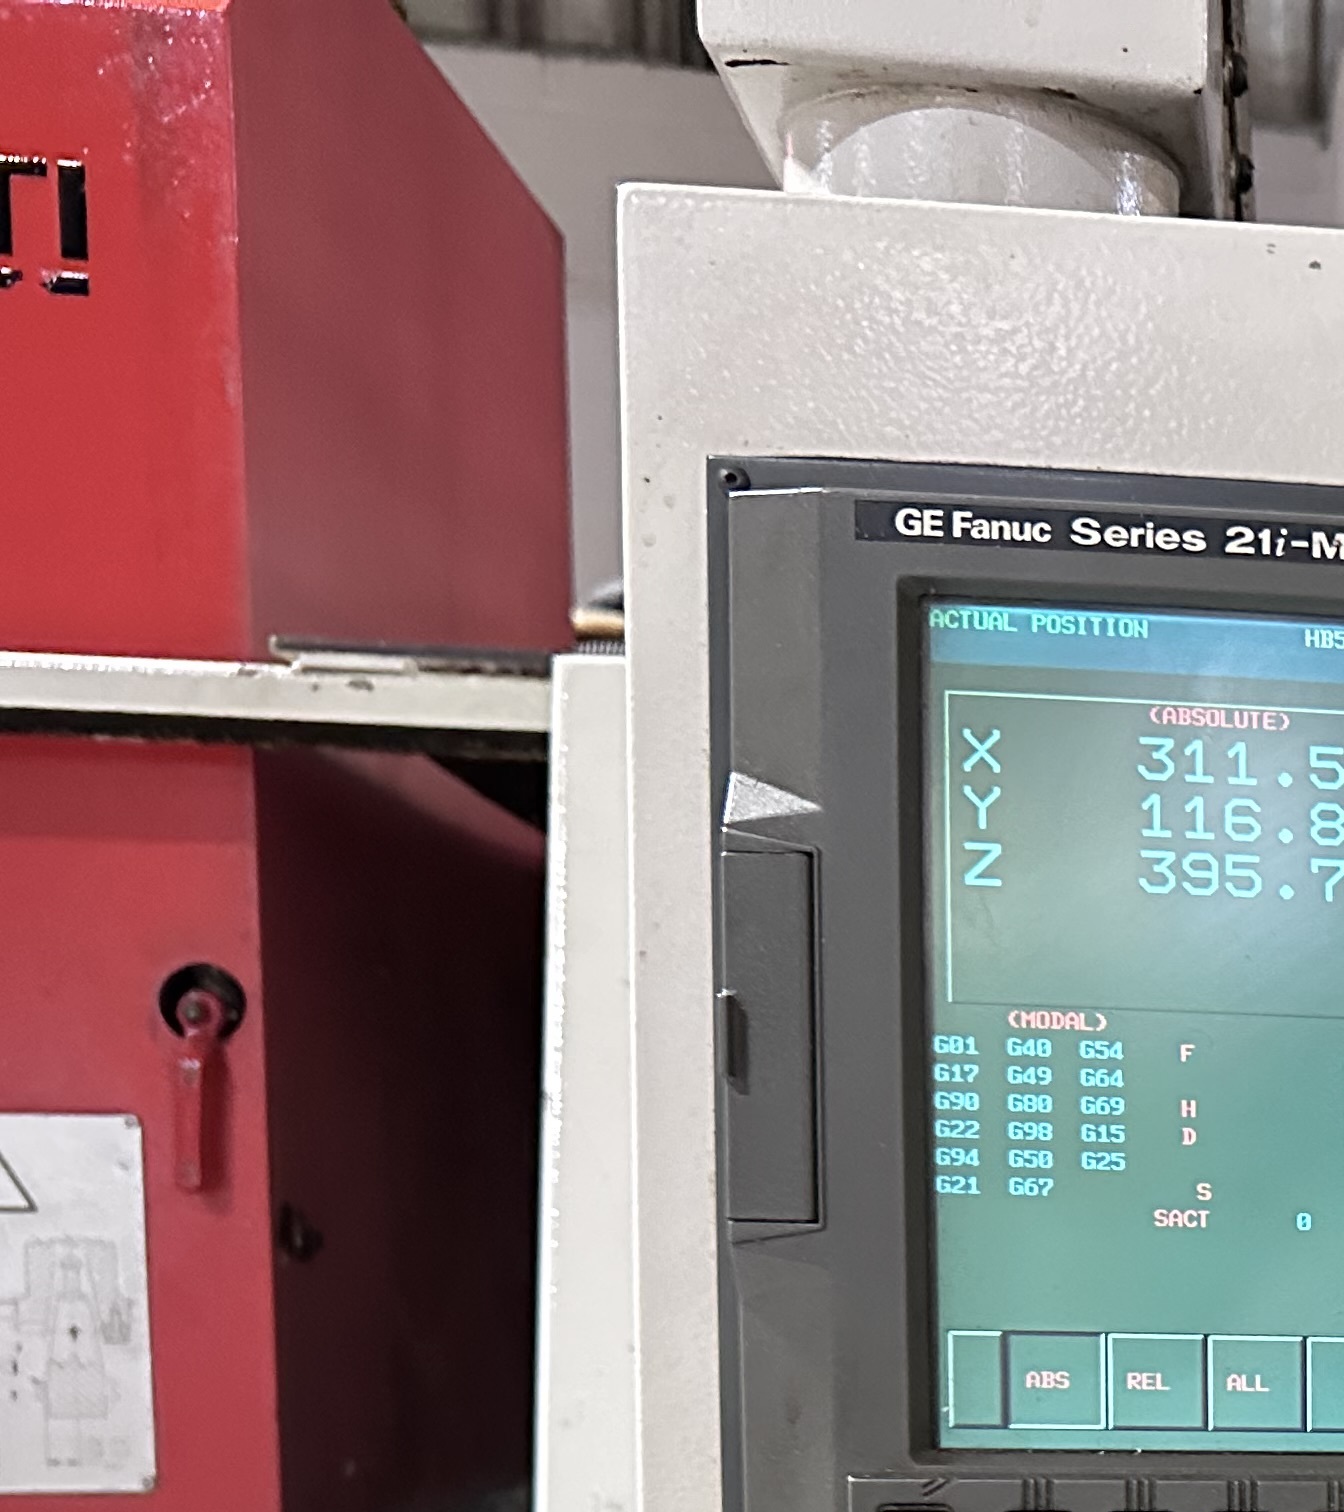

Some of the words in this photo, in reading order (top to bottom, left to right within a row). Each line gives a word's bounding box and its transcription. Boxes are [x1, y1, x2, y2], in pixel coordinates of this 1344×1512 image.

[895, 508, 944, 537] GE
[953, 511, 1051, 542] Fanuc
[1070, 516, 1206, 554] Series
[930, 609, 1017, 633] ACTUAL
[1031, 614, 1149, 639] POSITION
[1149, 706, 1291, 732] (ABSOLUTE)
[963, 729, 1000, 773] X
[964, 785, 1001, 829] Y
[963, 842, 1002, 886] Z
[1008, 1010, 1107, 1031] (MODAL)
[934, 1035, 979, 1055] G01
[1007, 1038, 1051, 1057] G40
[1079, 1041, 1124, 1060] G54
[1181, 1044, 1195, 1062] F
[934, 1064, 979, 1084] G17
[1007, 1066, 1052, 1085] G49
[1080, 1069, 1124, 1087] G64
[934, 1092, 979, 1112] G90
[1008, 1094, 1052, 1113] G80
[1081, 1096, 1124, 1115] G69
[1182, 1100, 1196, 1117] H
[934, 1120, 980, 1140] G22
[1008, 1122, 1053, 1140] G98
[1081, 1124, 1125, 1143] G15
[1182, 1128, 1196, 1145] D
[935, 1148, 980, 1168] G94
[1009, 1150, 1053, 1168] G50
[1082, 1152, 1125, 1170] G25
[936, 1175, 980, 1196] G21
[1009, 1177, 1053, 1196] G67
[1197, 1183, 1212, 1200] S
[1154, 1209, 1210, 1227] SACT
[1295, 1213, 1311, 1230] 0
[1025, 1371, 1070, 1391] ABS
[1127, 1372, 1171, 1392] REL
[1227, 1374, 1270, 1393] ALL
